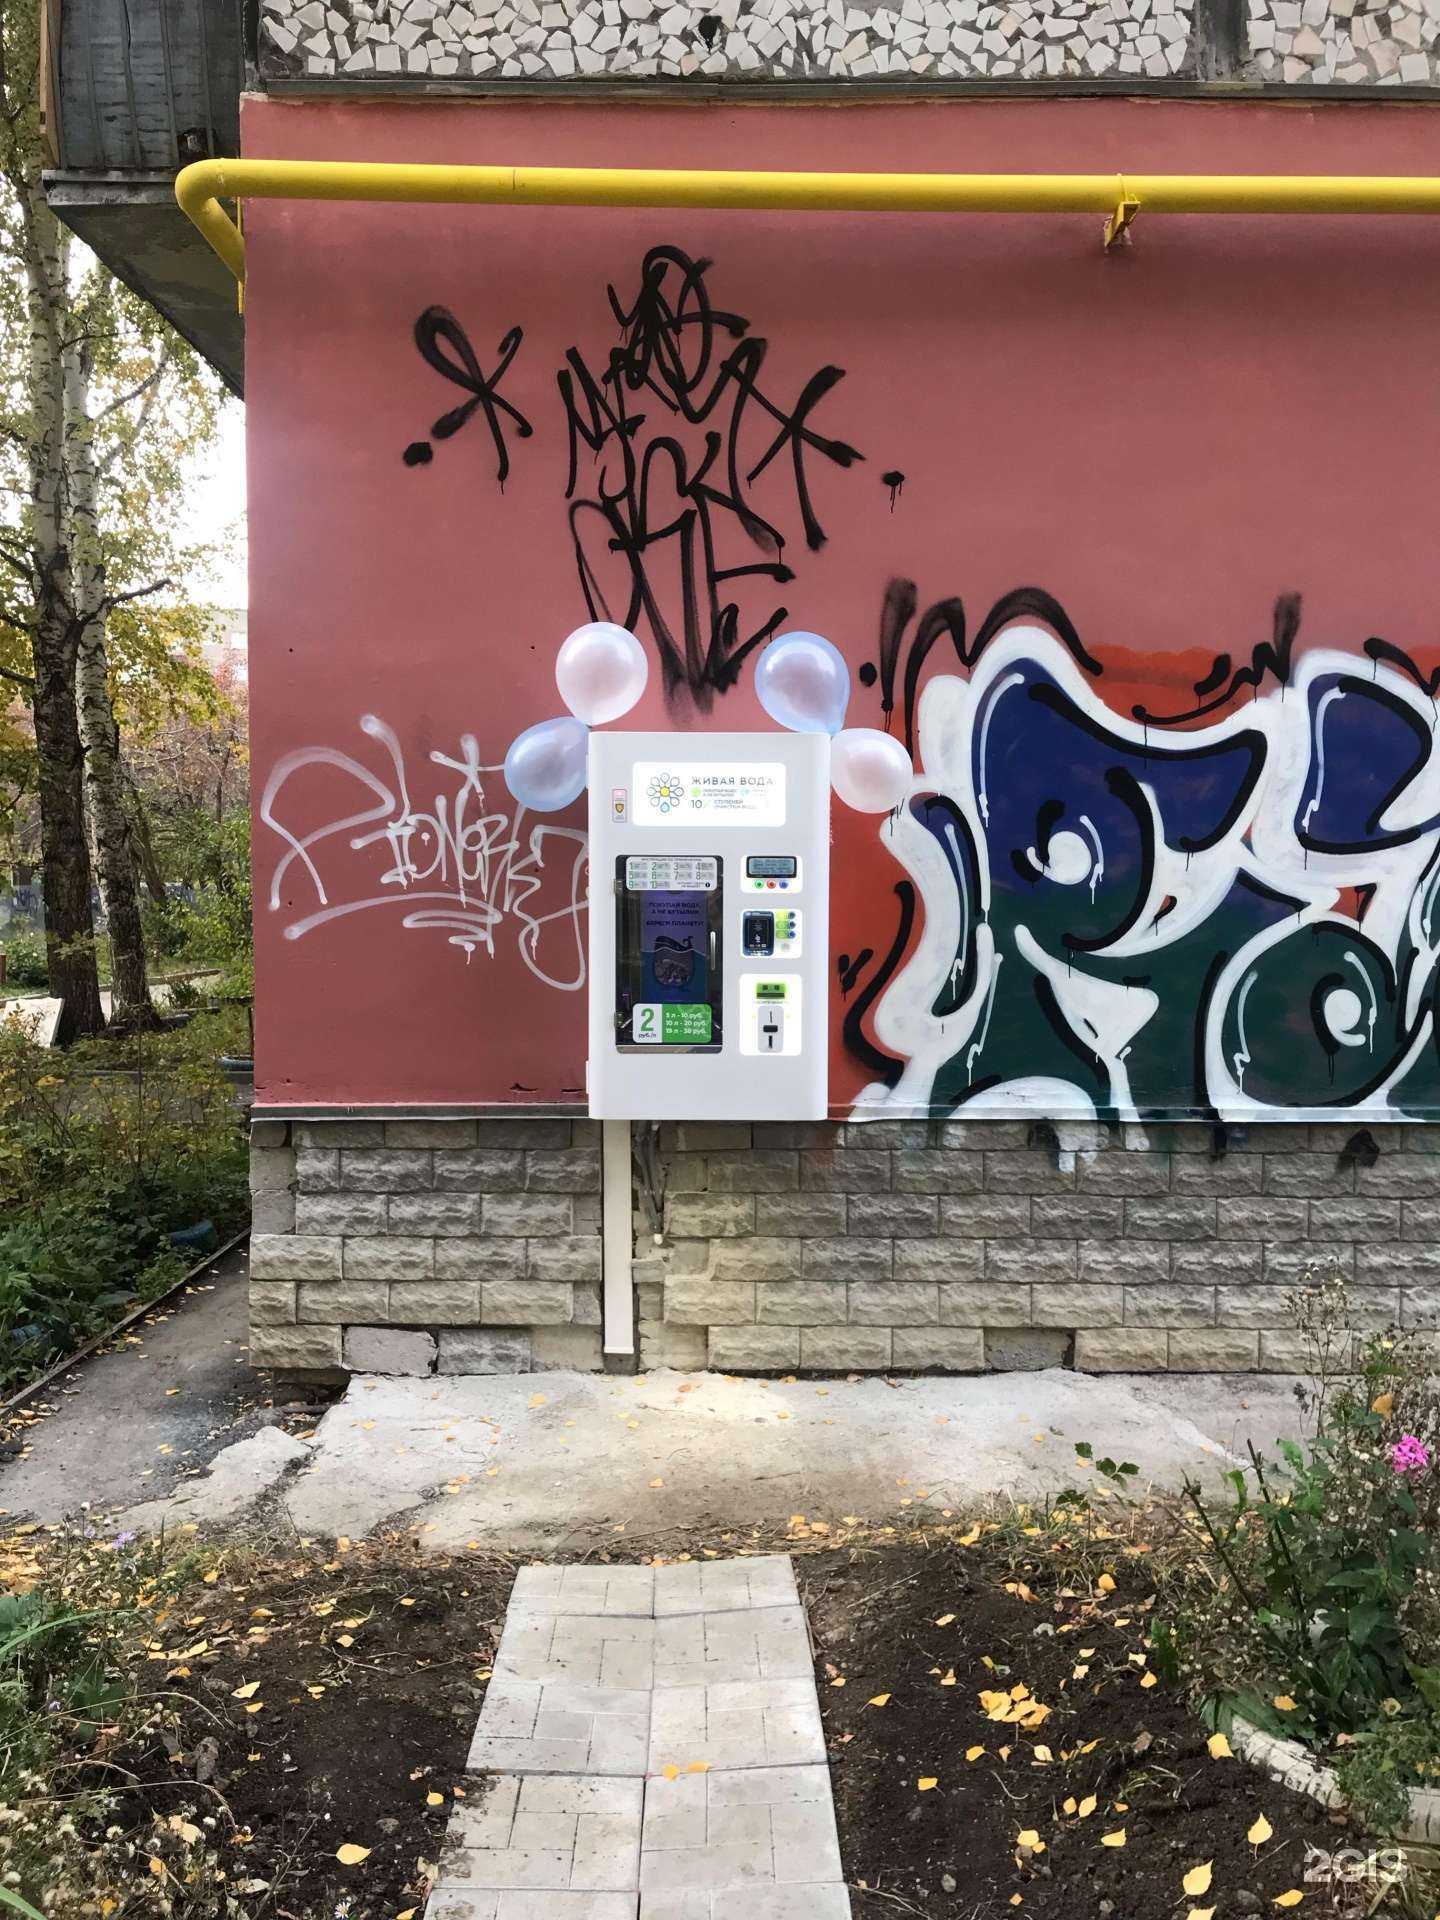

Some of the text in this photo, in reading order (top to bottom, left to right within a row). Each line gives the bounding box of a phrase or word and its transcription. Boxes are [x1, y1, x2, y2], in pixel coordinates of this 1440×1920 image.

[691, 777, 774, 786] ЖИВАЯ ВОДА
[690, 800, 702, 808] 10
[652, 862, 657, 870] 2
[673, 862, 678, 870] 3
[674, 871, 679, 880] 7
[696, 871, 701, 880] 8
[640, 1008, 654, 1032] 2
